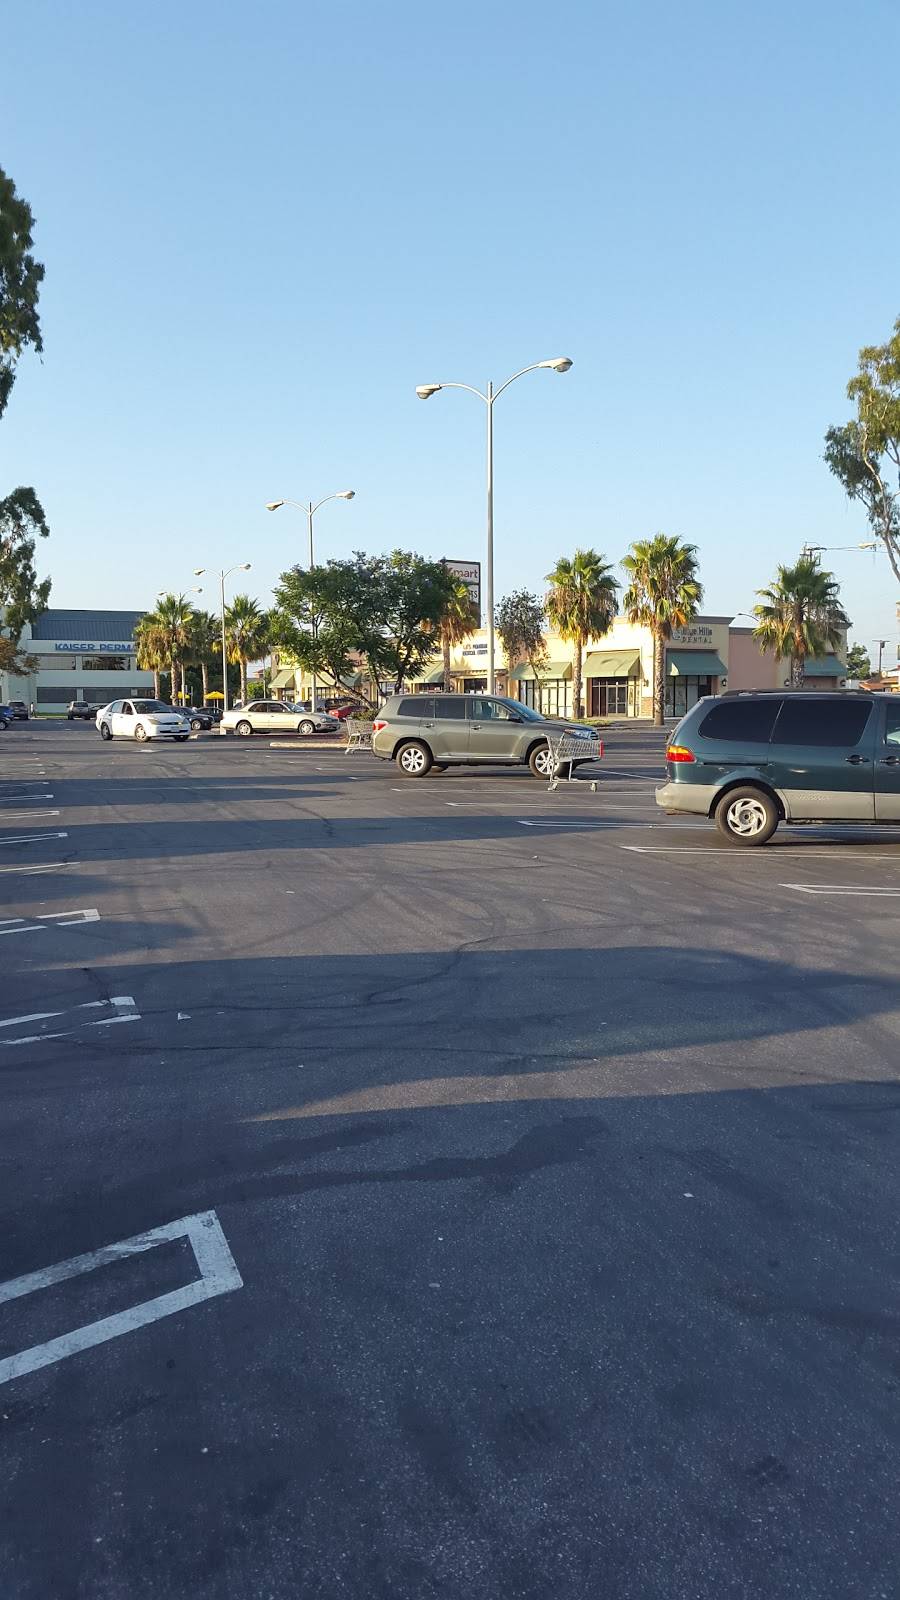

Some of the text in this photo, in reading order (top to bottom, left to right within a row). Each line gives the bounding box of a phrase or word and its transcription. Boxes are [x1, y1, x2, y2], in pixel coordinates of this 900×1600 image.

[698, 626, 713, 636] Hills
[682, 636, 713, 644] DENTAL
[55, 643, 96, 652] KAISER
